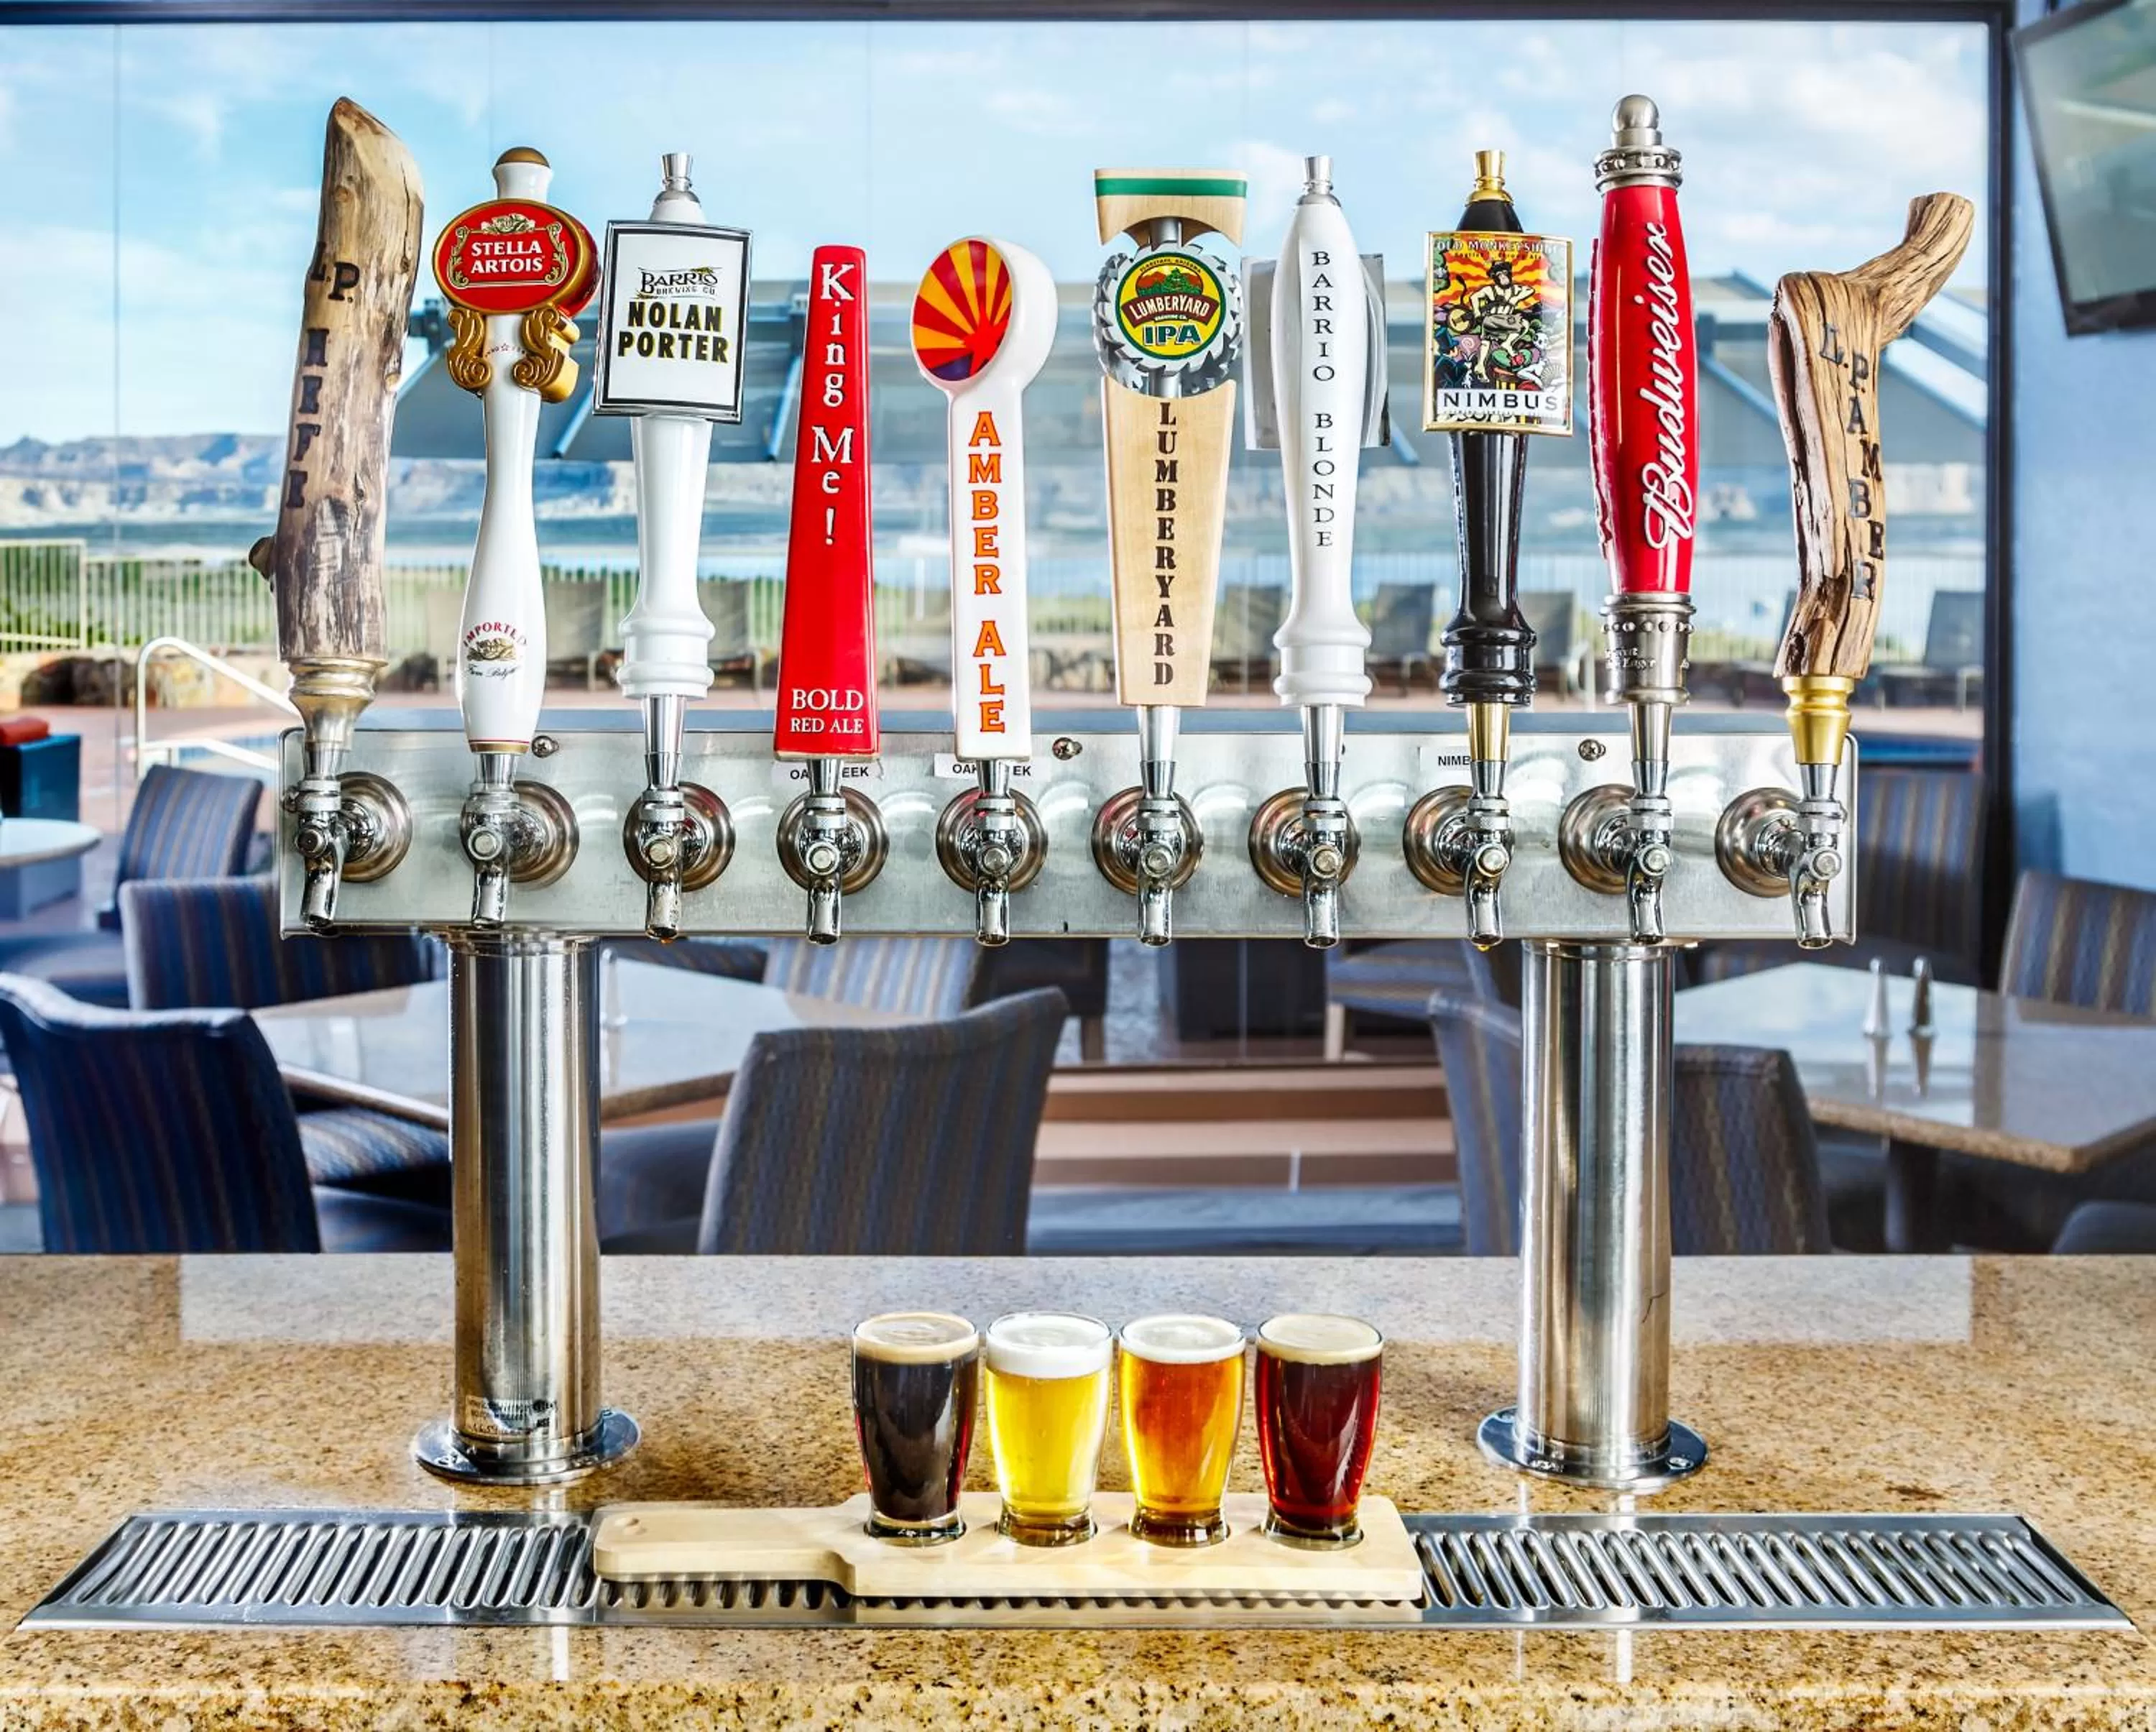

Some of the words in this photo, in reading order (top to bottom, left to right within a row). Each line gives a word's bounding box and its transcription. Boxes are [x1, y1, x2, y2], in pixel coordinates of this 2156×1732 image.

[471, 240, 542, 257] STELLA
[471, 257, 543, 274] ARTOIS
[640, 271, 718, 294] BARRIO
[627, 301, 722, 333] NOLAN
[1129, 294, 1210, 320] LUMBERYARD
[1312, 252, 1335, 382] BARRIO
[617, 331, 729, 364] PORTER
[820, 264, 855, 408] King
[1143, 323, 1203, 346] IPA
[1443, 392, 1558, 410] NIMBUS
[1634, 222, 1693, 550] Budweiser
[811, 425, 854, 545] Me!
[1312, 413, 1335, 547] BLONDE
[968, 411, 1003, 595] AMBER
[1847, 397, 1884, 602] AMBER
[1154, 402, 1179, 686] LUMBERYARD
[973, 620, 1007, 733] ALE
[791, 688, 864, 711] BOLD
[791, 718, 825, 733] RED
[829, 718, 865, 734] ALE
[791, 768, 809, 780] OA
[1438, 755, 1472, 765] NIMB
